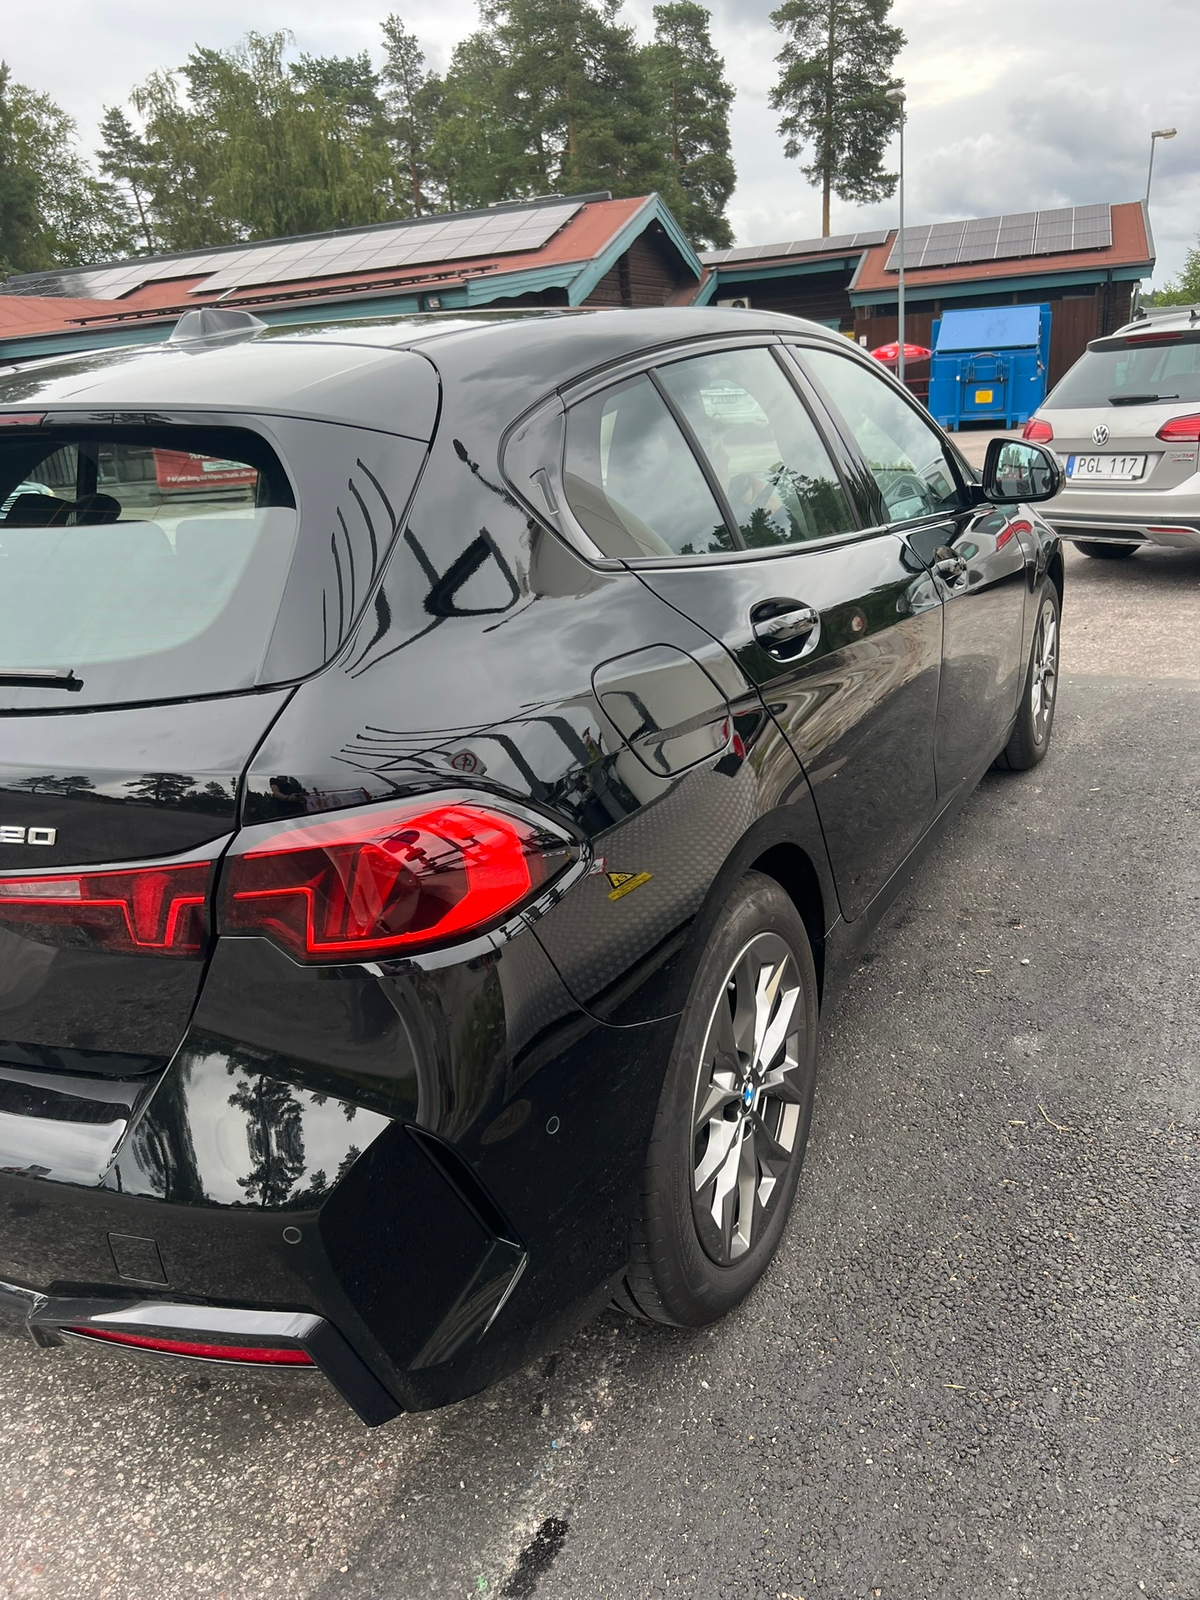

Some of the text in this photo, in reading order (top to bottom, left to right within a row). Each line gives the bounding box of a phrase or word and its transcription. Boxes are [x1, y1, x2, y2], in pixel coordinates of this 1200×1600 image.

[1077, 457, 1138, 474] PGL 117
[0, 825, 57, 846] 20
